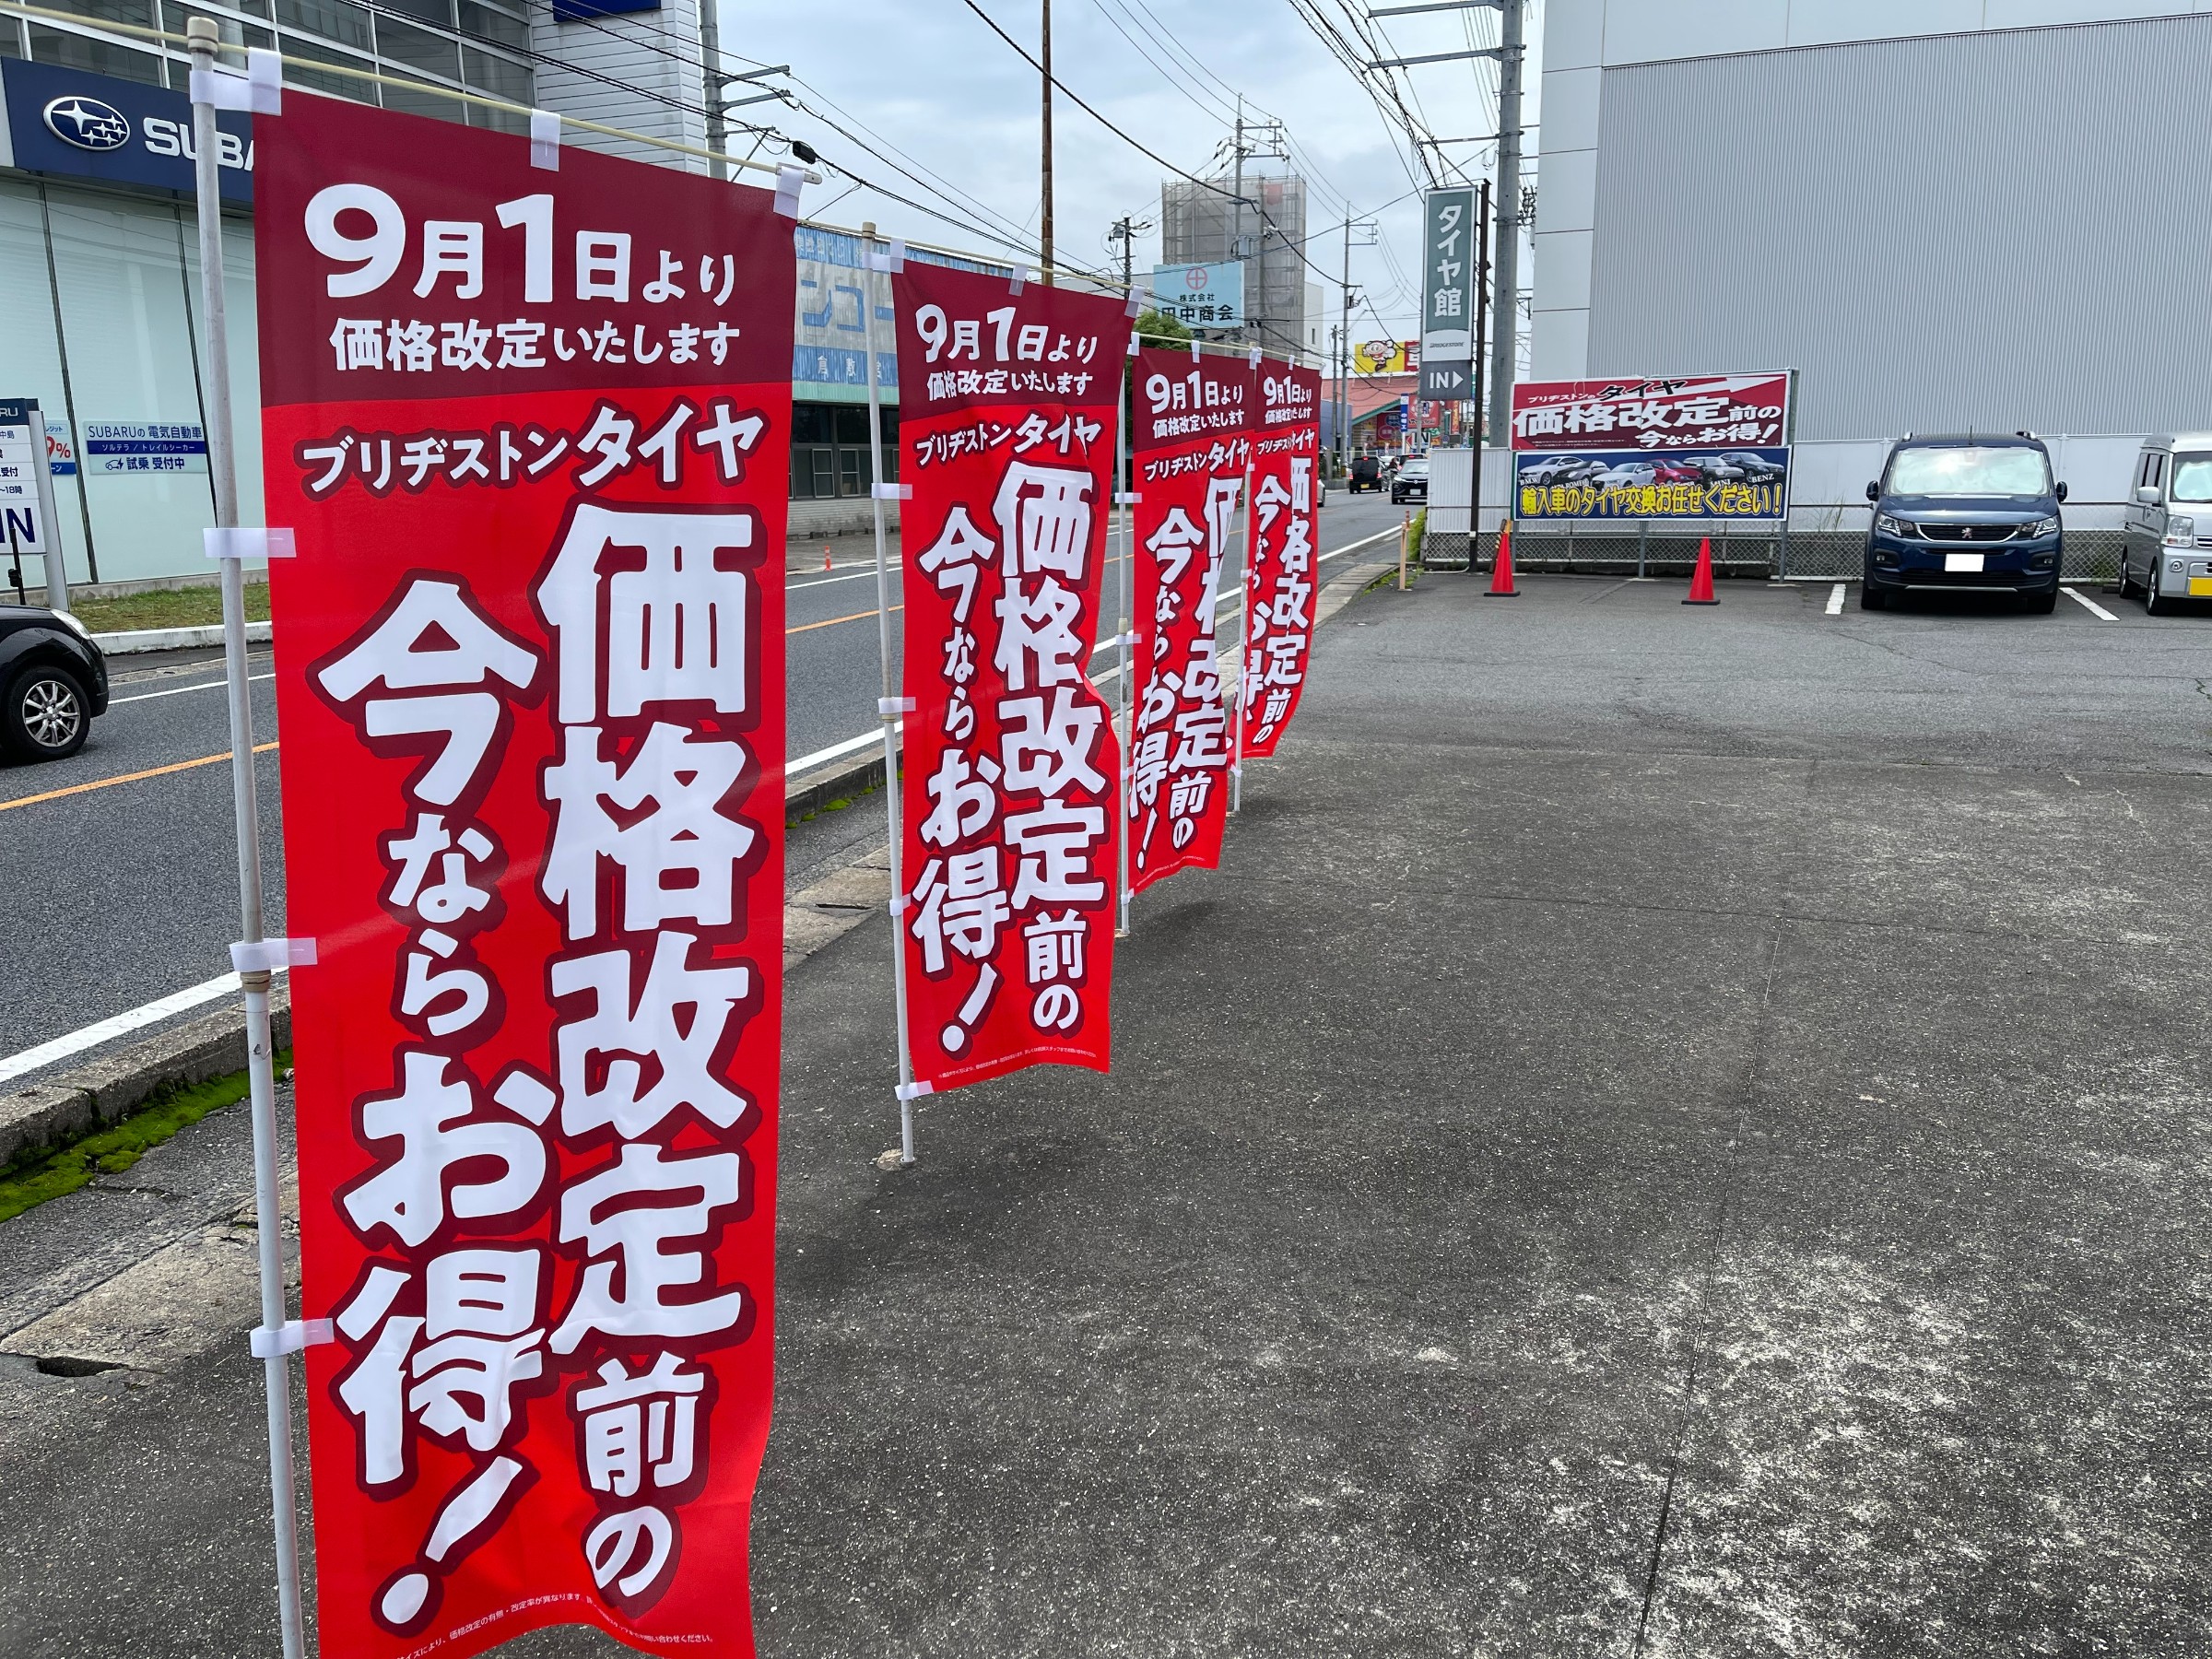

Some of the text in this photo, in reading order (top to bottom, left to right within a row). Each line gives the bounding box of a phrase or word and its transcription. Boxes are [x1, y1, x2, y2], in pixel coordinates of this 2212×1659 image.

[305, 183, 735, 307] 9月1日より
[1435, 205, 1463, 317] タイヤ館
[1179, 293, 1215, 302] 株式会社
[329, 317, 739, 372] 価格改定いたします
[916, 304, 1097, 364] 9月1日より
[927, 370, 1093, 401] 価格改定いたします
[1146, 371, 1243, 414] 9月1日より
[1264, 376, 1312, 406] 9月1日より
[1430, 371, 1449, 389] IN
[88, 426, 202, 440] SUBARUの 電気自動車
[1153, 409, 1244, 439] 価格改定いたします
[1512, 396, 1783, 437] 価格改定前の
[1636, 423, 1780, 448] 今ならお得!
[303, 404, 764, 495] ブリヂストンタイヤ
[916, 414, 1101, 465] ブリヂストンタイヤ
[1145, 438, 1250, 480] ブリヂストンタイヤ
[126, 456, 185, 470] 試乗 受付中
[1752, 474, 1774, 485] BENZ
[1522, 484, 1783, 516] 輸入車のタイヤ交換お任せください!
[993, 461, 1106, 1029] 価格改定前の
[912, 506, 1009, 1051] 今ならお得!
[539, 510, 754, 1597] 価格改定前の
[318, 580, 557, 1624] 今ならお得!
